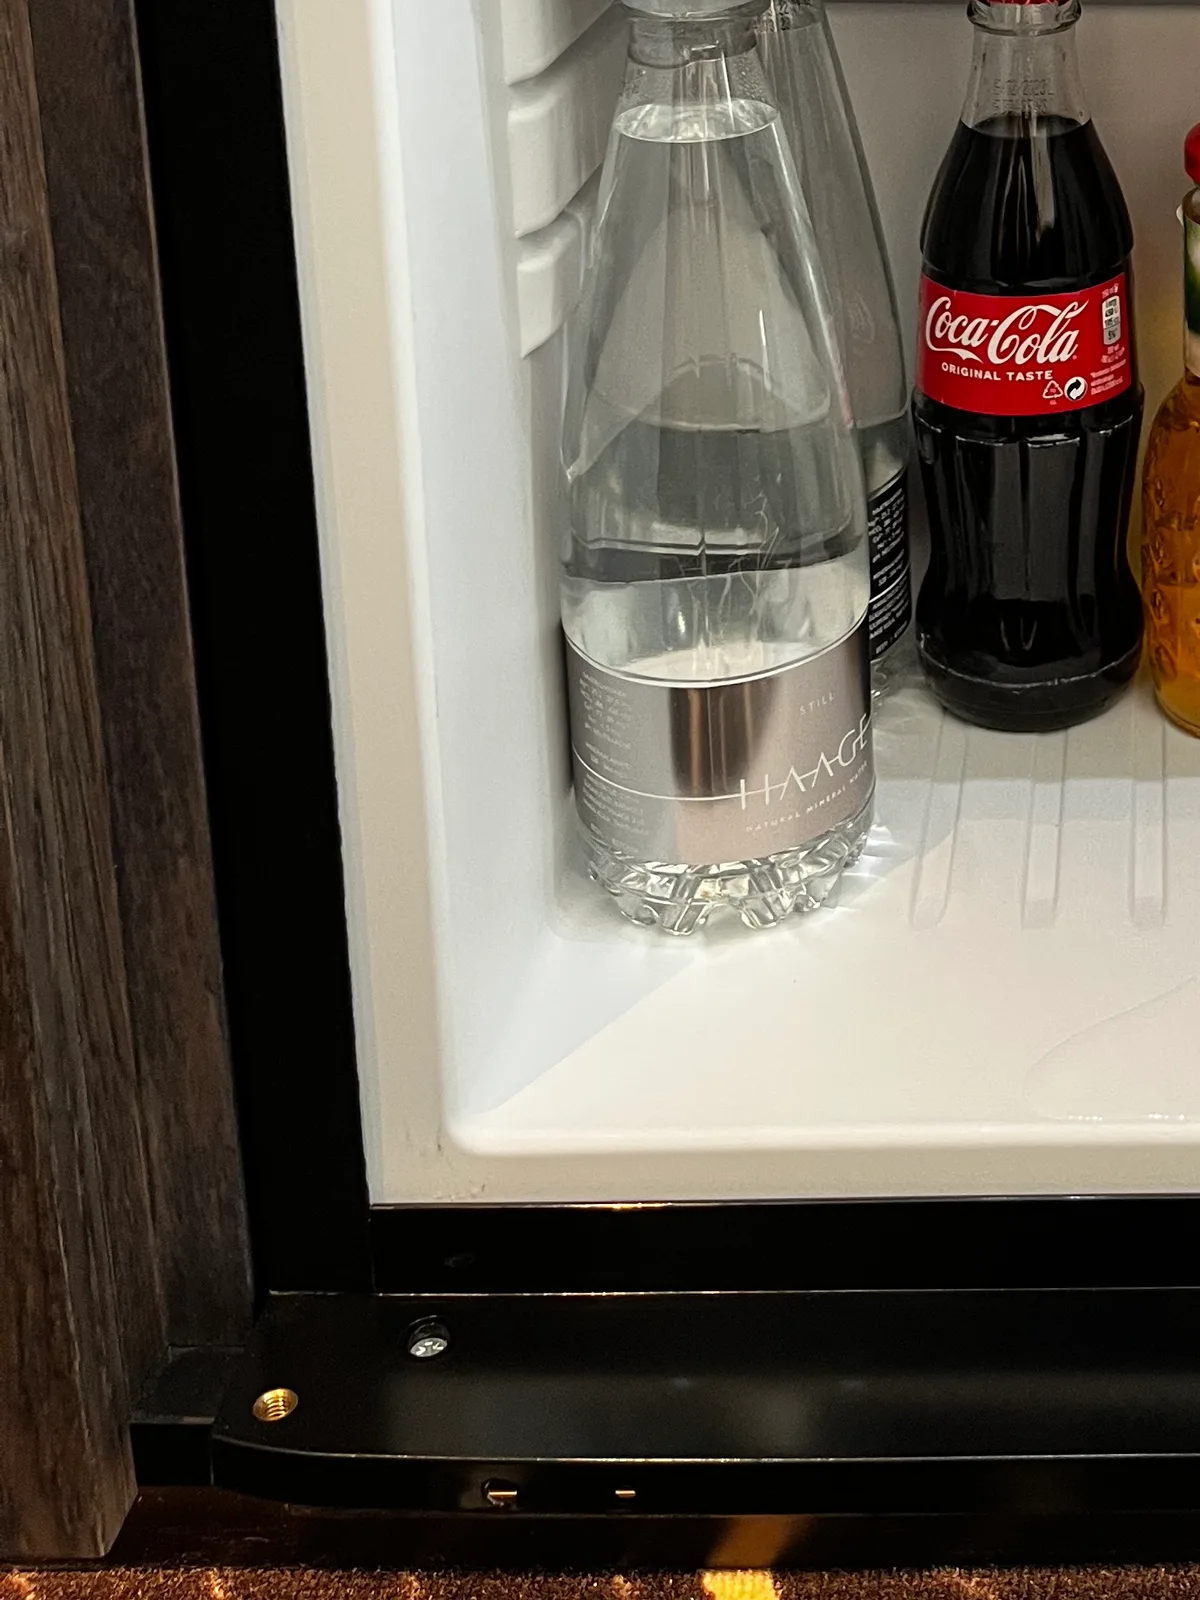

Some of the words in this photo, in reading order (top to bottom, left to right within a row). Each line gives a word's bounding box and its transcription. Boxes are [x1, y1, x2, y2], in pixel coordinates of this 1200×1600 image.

[925, 296, 1090, 365] Coca-Cola
[941, 362, 1002, 381] ORIGINAL
[1006, 370, 1053, 381] TASTE
[800, 691, 835, 716] STILL
[746, 812, 801, 833] NATURAL
[806, 785, 847, 814] MINERAL
